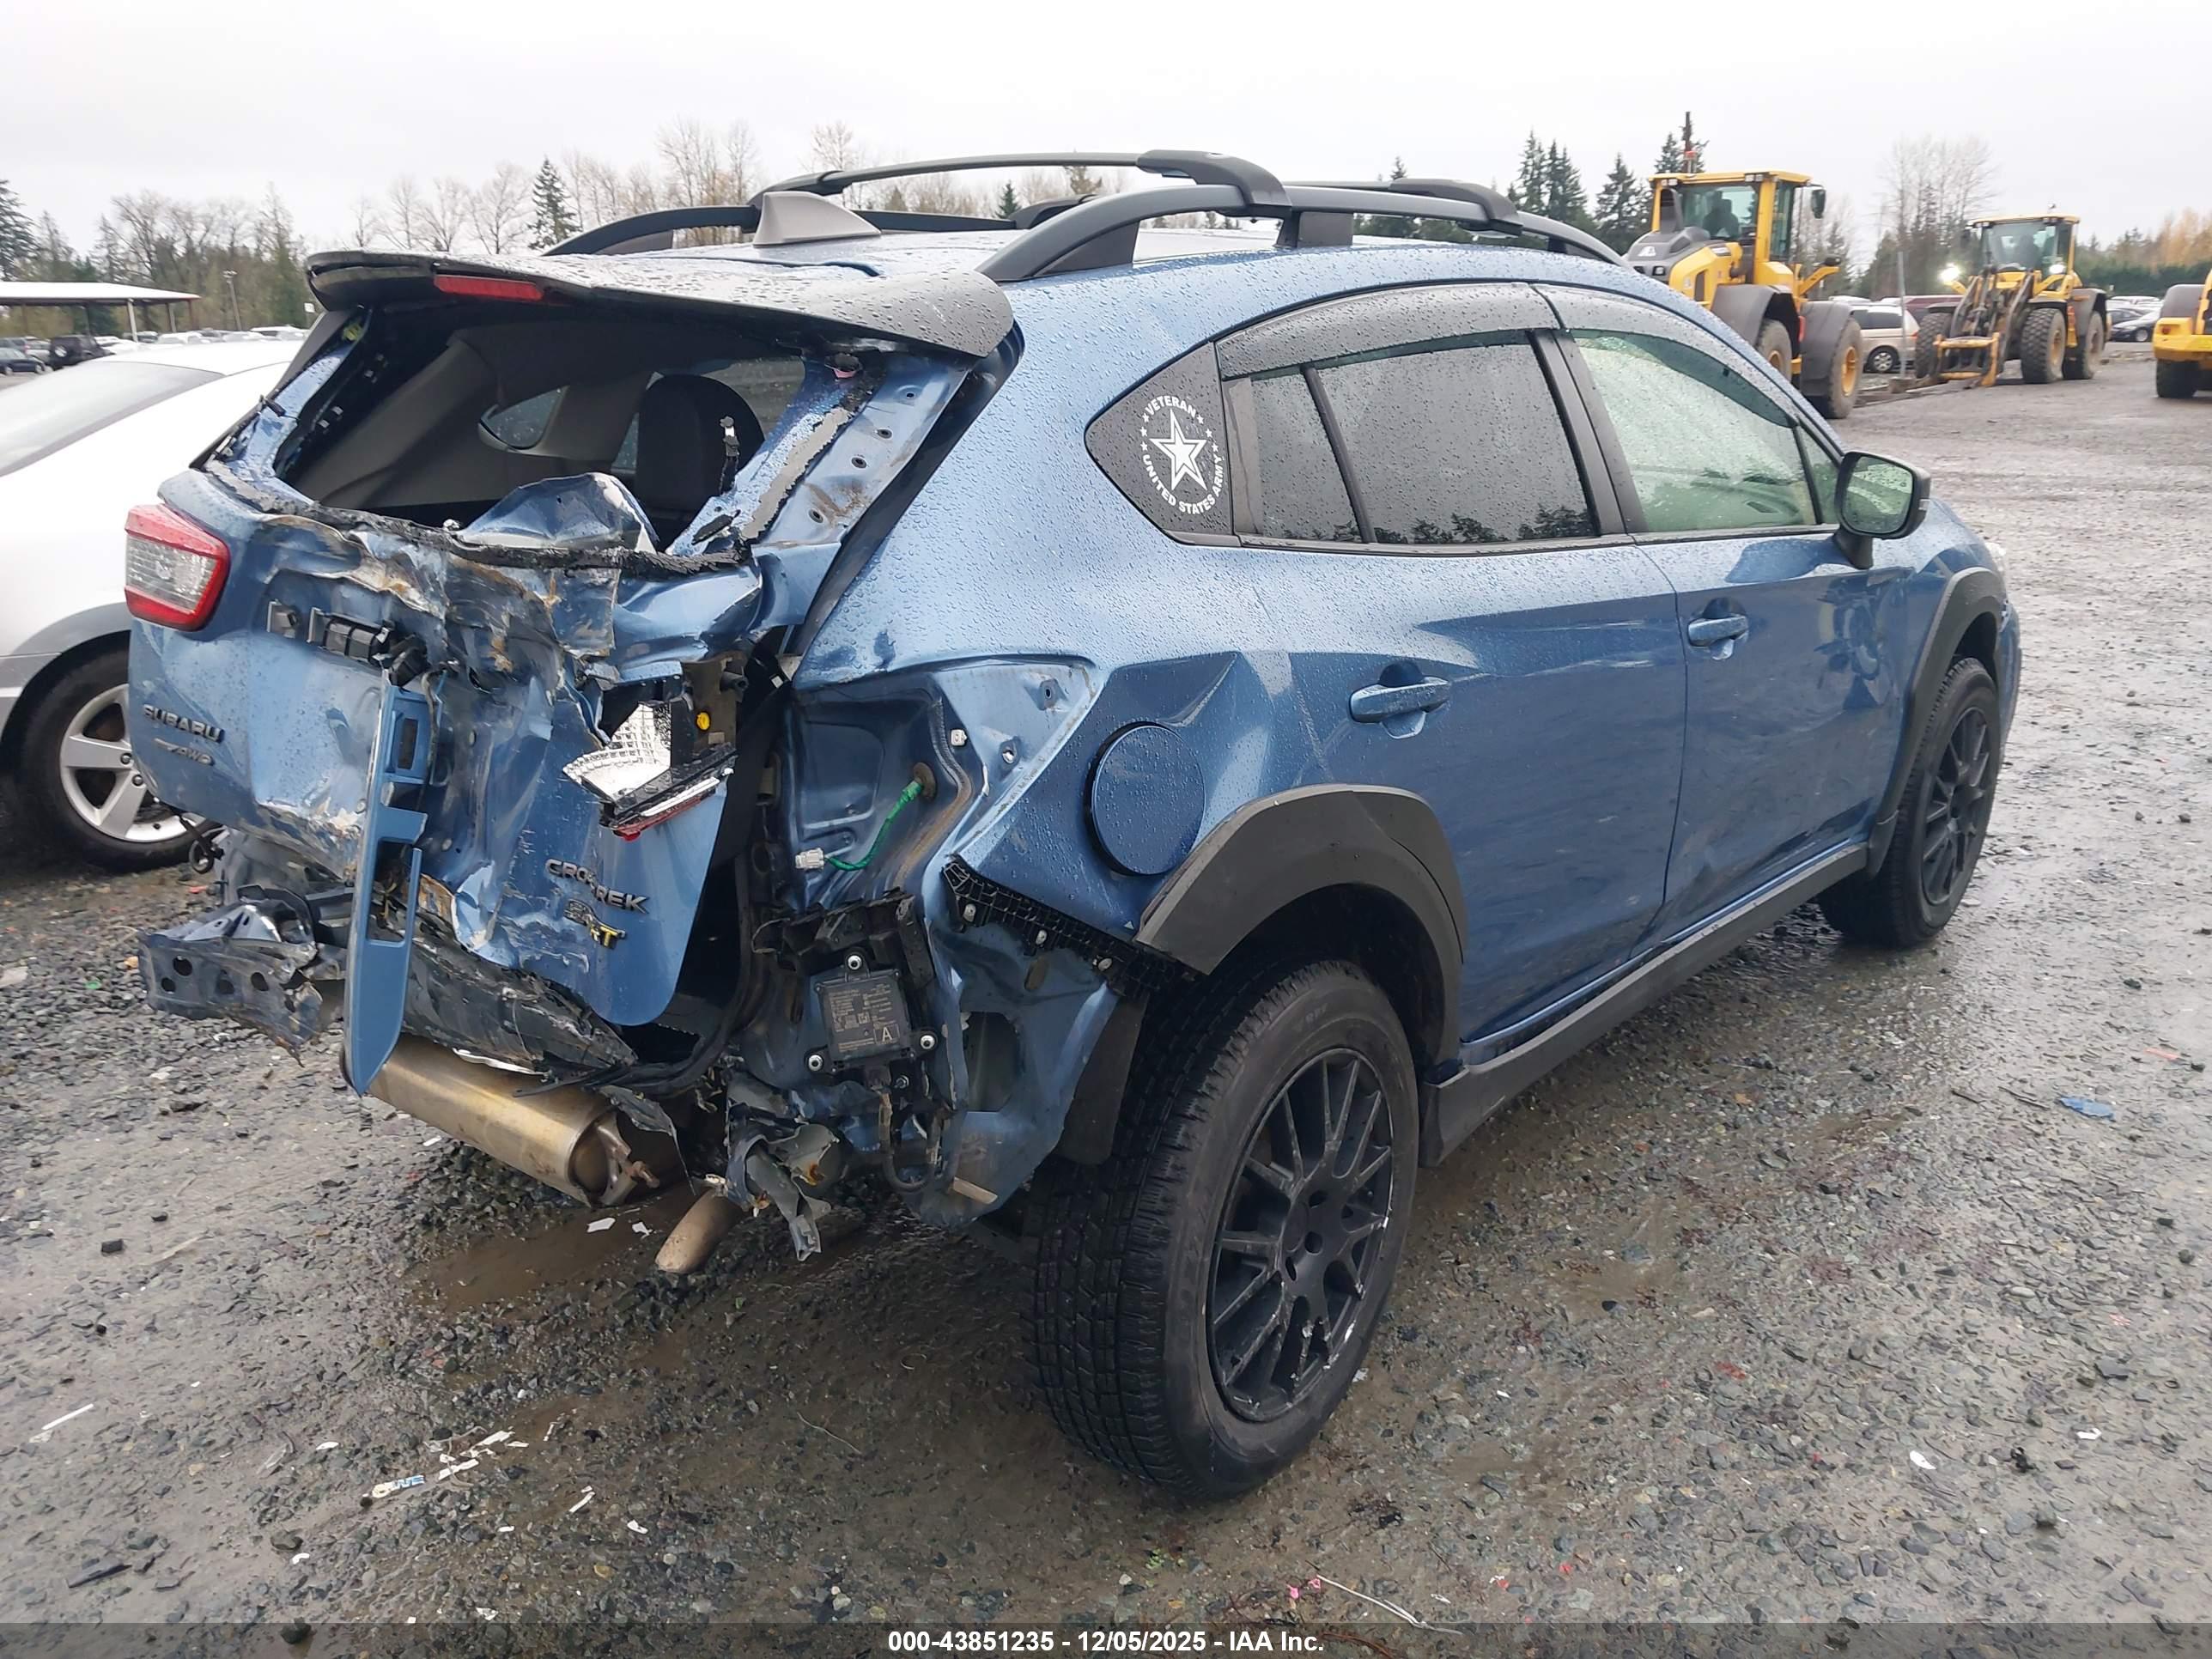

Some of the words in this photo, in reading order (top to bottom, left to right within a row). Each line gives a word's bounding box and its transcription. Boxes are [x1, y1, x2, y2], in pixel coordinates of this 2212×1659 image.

[1145, 395, 1196, 418] VETERAN
[1142, 454, 1176, 506] UNITED
[1178, 494, 1216, 515] STATES
[1212, 454, 1224, 496] ARMY
[143, 703, 225, 744] SUBARU
[881, 1026, 893, 1042] A
